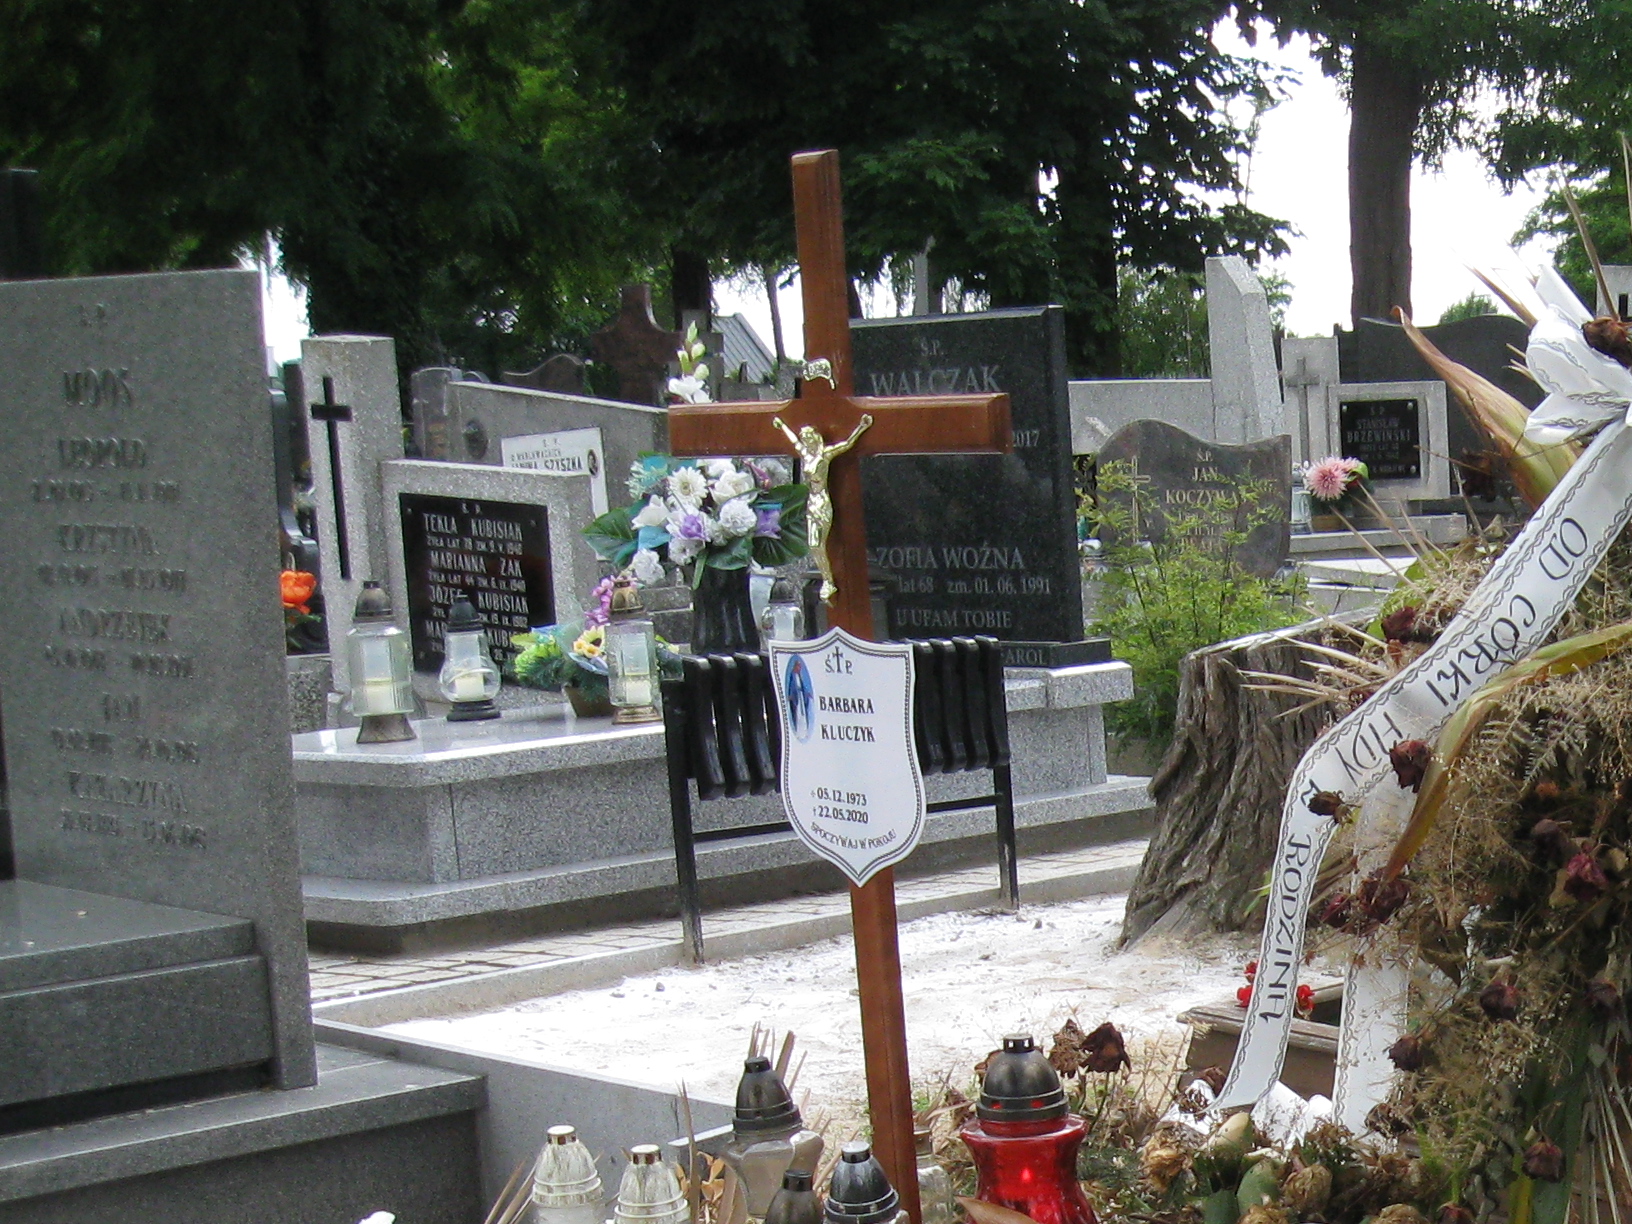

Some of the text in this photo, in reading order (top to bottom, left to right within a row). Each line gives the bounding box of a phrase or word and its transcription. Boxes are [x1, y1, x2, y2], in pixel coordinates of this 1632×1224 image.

[869, 365, 1002, 396] WALCZAK
[1192, 467, 1219, 482] JAN
[422, 513, 523, 542] TEKLA KUBISIAK
[876, 541, 1025, 570] ZOFIA WOŹNA
[1539, 517, 1588, 580] OD
[430, 550, 487, 574] MARIANNA
[1021, 576, 1051, 595] 1991
[478, 591, 529, 614] KUBISIAK
[911, 608, 957, 627] UFAM
[963, 610, 1013, 629] TOBIE
[819, 695, 875, 714] BARBARA
[821, 724, 876, 743] KLUCZYK
